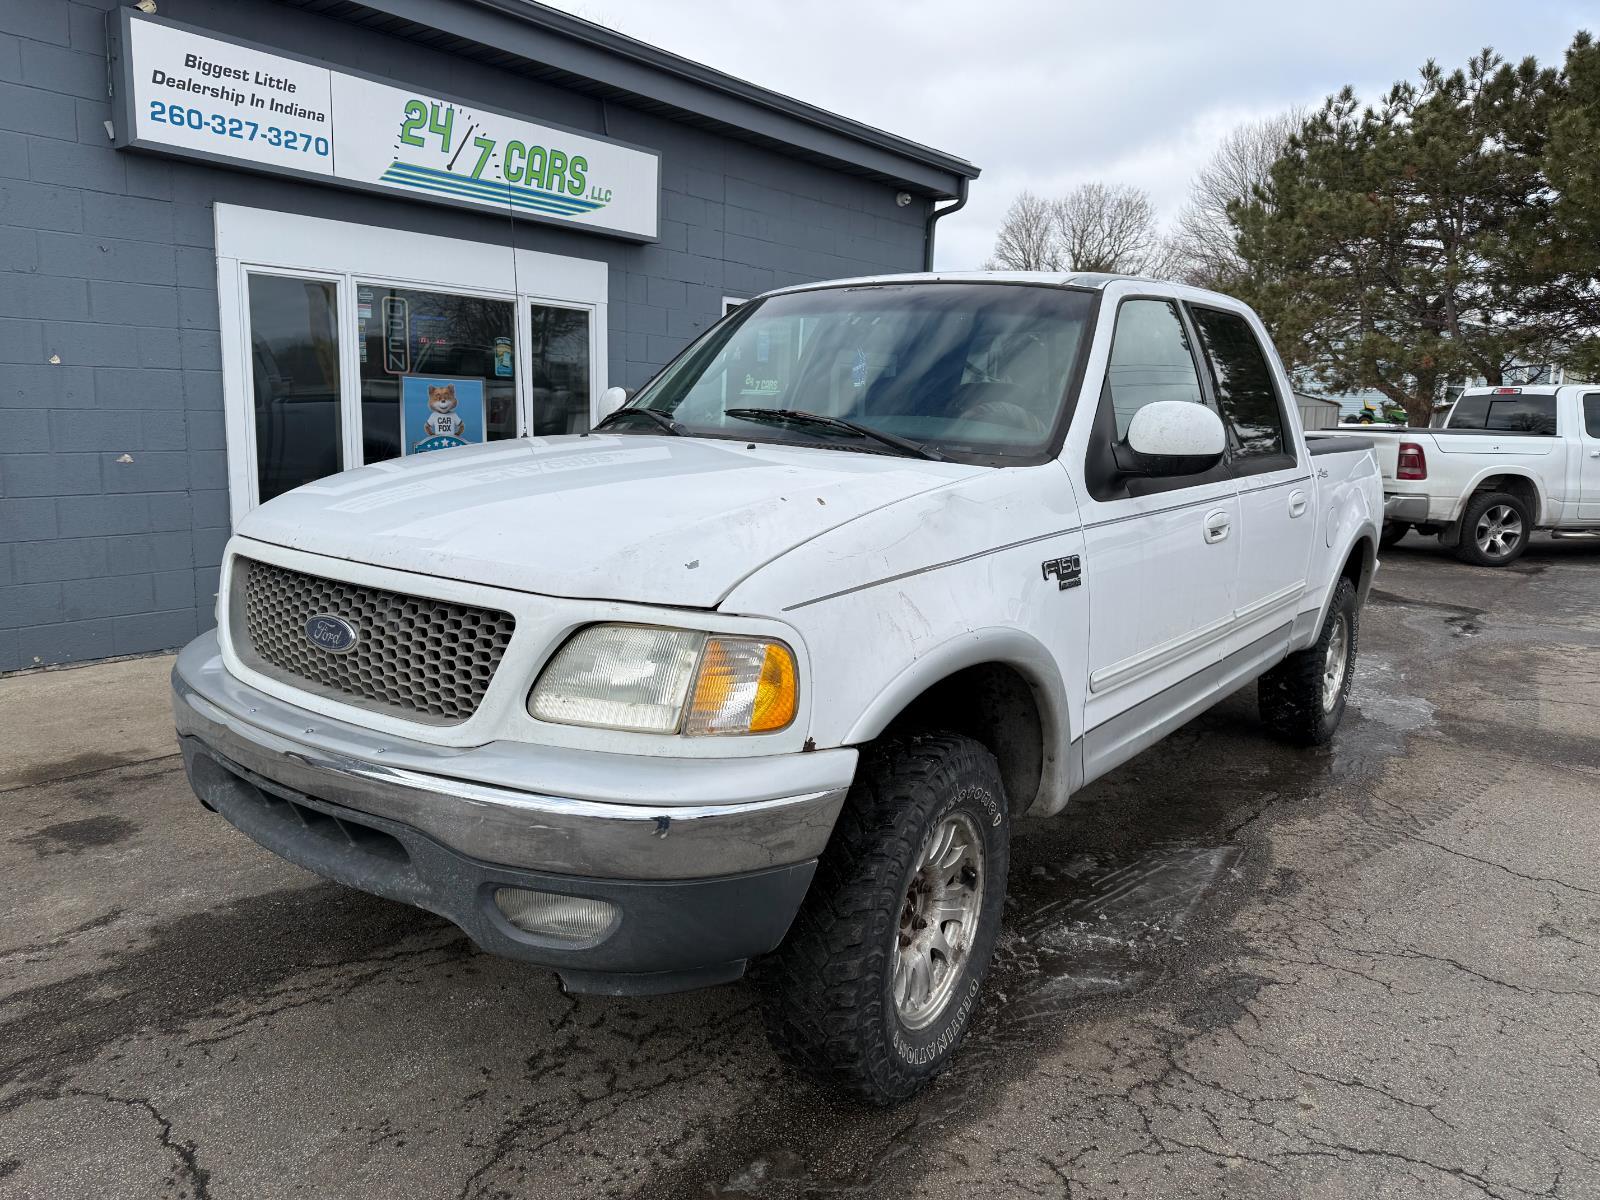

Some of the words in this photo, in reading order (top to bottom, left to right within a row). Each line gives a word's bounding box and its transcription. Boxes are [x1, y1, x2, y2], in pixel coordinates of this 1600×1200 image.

[184, 53, 249, 82] Biggest
[254, 71, 297, 94] Little
[151, 69, 245, 107] Dealership
[249, 93, 265, 109] In
[269, 98, 325, 123] Indiana
[150, 101, 329, 156] 260-327-3270
[388, 301, 405, 370] OPEN
[437, 417, 452, 425] CAR
[438, 424, 452, 432] FOX
[314, 620, 342, 645] Ford
